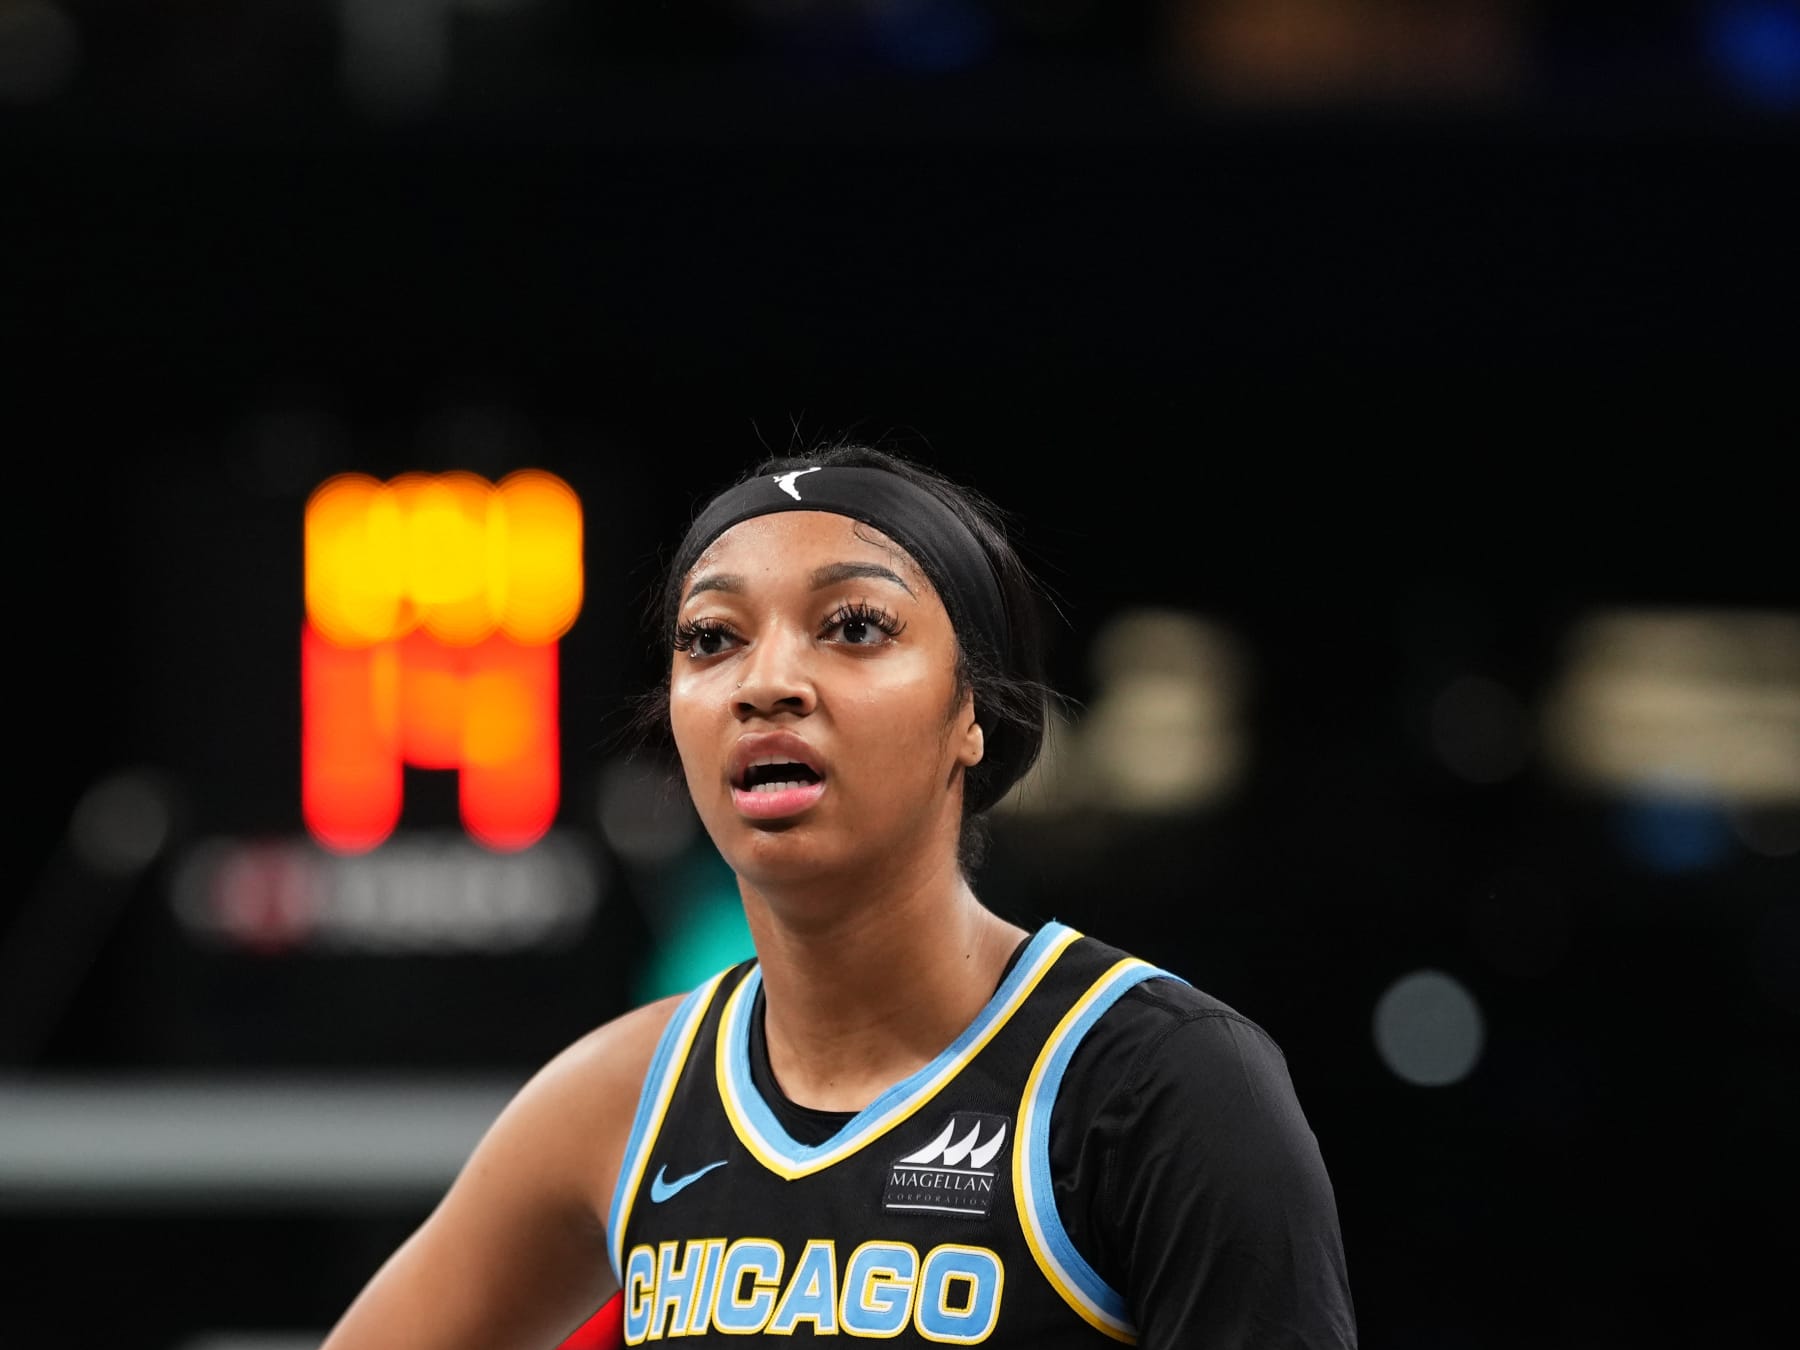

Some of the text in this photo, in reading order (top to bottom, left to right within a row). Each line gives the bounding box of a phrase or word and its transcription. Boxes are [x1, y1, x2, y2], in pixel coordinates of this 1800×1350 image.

[890, 1172, 993, 1192] MAGELLAN
[887, 1193, 987, 1206] CORPORATION
[623, 1237, 1005, 1346] CHICAGO
